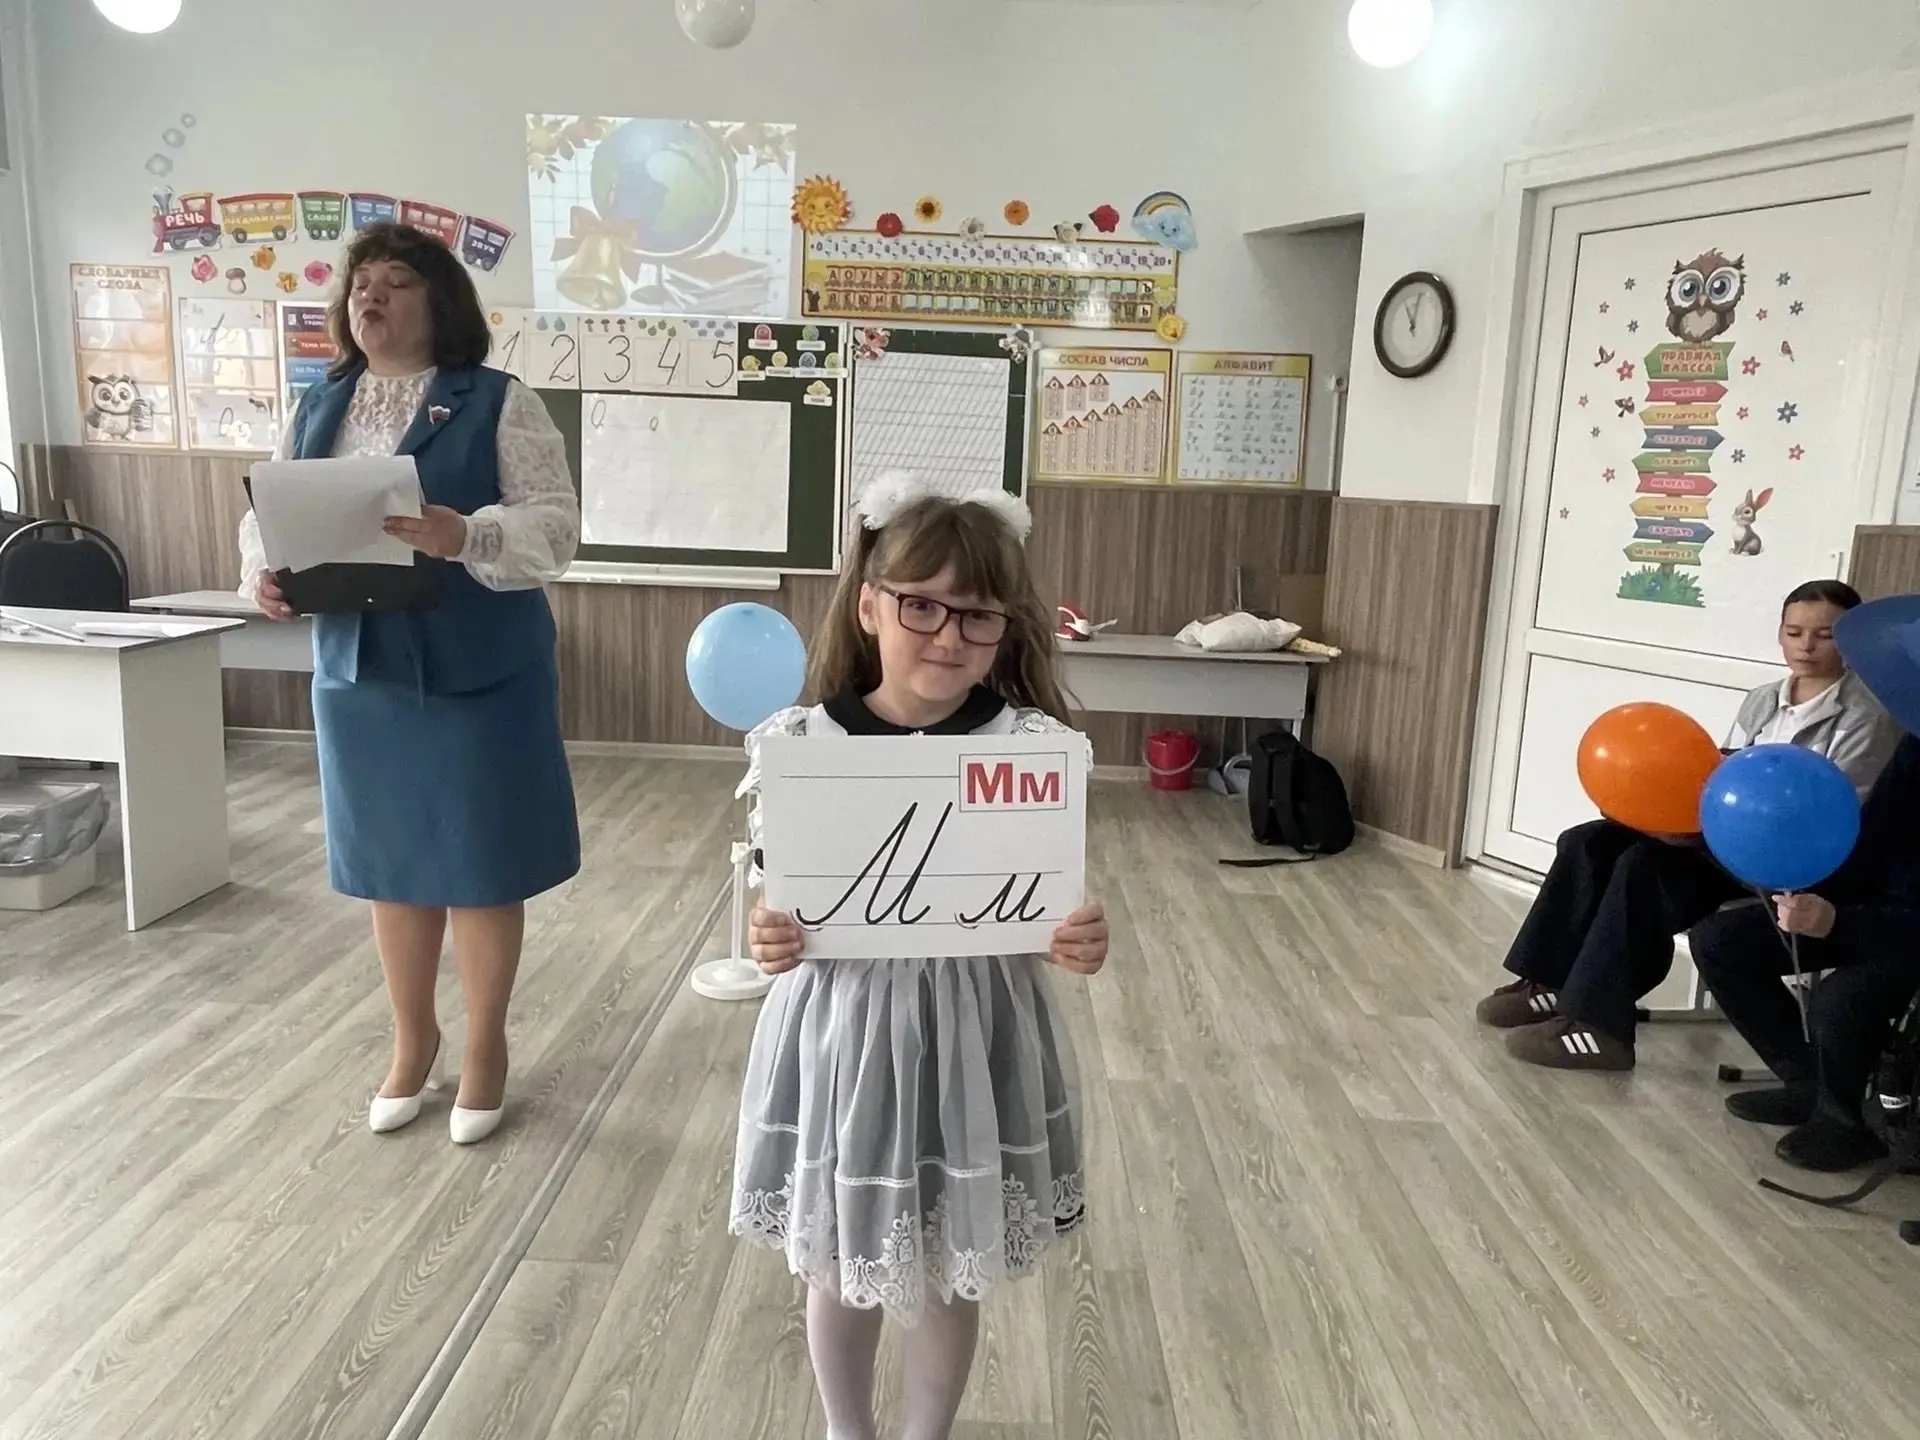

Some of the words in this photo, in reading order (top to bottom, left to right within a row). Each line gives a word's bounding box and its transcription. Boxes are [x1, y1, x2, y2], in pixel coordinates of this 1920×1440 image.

[165, 212, 205, 227] РЕЧЬ
[307, 213, 339, 221] СЛОВО
[471, 239, 496, 254] ЗВУК
[1153, 256, 1166, 266] 20
[98, 279, 142, 290] СЛОВА
[503, 330, 521, 372] 1
[549, 333, 575, 382] 2
[604, 335, 631, 383] 3
[658, 338, 681, 386] 4
[705, 340, 735, 388] 5
[1059, 354, 1106, 366] СОСТАВ
[1109, 355, 1150, 367] ЧИСЛА
[1662, 351, 1720, 361] ПРАВИЛА
[1214, 359, 1274, 371] АЛФАВИТ
[1663, 362, 1713, 373] КЛАССА
[967, 762, 1060, 805] Мм
